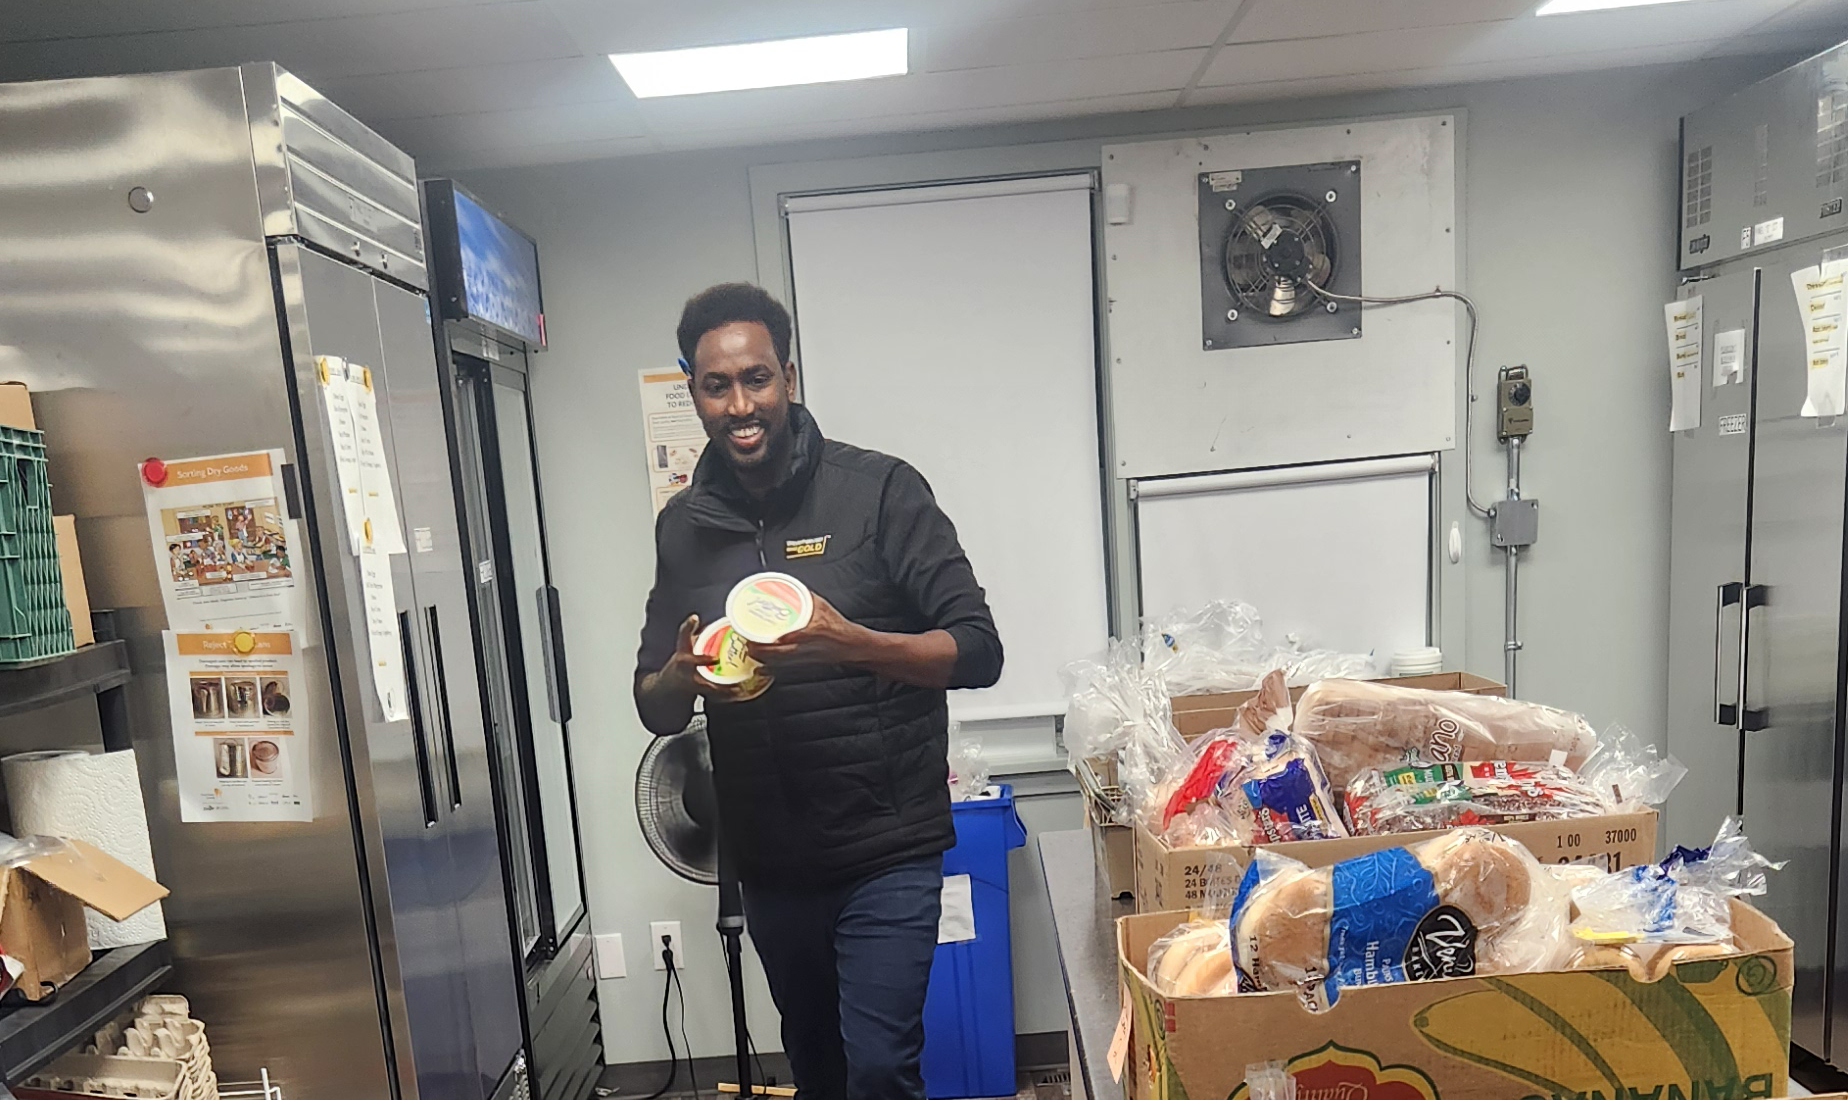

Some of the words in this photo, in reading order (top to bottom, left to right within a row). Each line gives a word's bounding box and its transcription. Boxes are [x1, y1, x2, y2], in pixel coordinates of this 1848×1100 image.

[666, 392, 686, 400] FOOD
[1720, 415, 1746, 432] FREEZER
[177, 469, 207, 479] Sorting
[207, 467, 221, 477] Dry
[223, 464, 249, 474] Goods
[202, 640, 227, 651] Reject
[1557, 835, 1563, 848] 1
[1567, 833, 1581, 847] 00
[1605, 828, 1637, 844] 37000
[1184, 879, 1197, 889] 24
[1184, 890, 1198, 899] 48
[1249, 935, 1259, 953] 12
